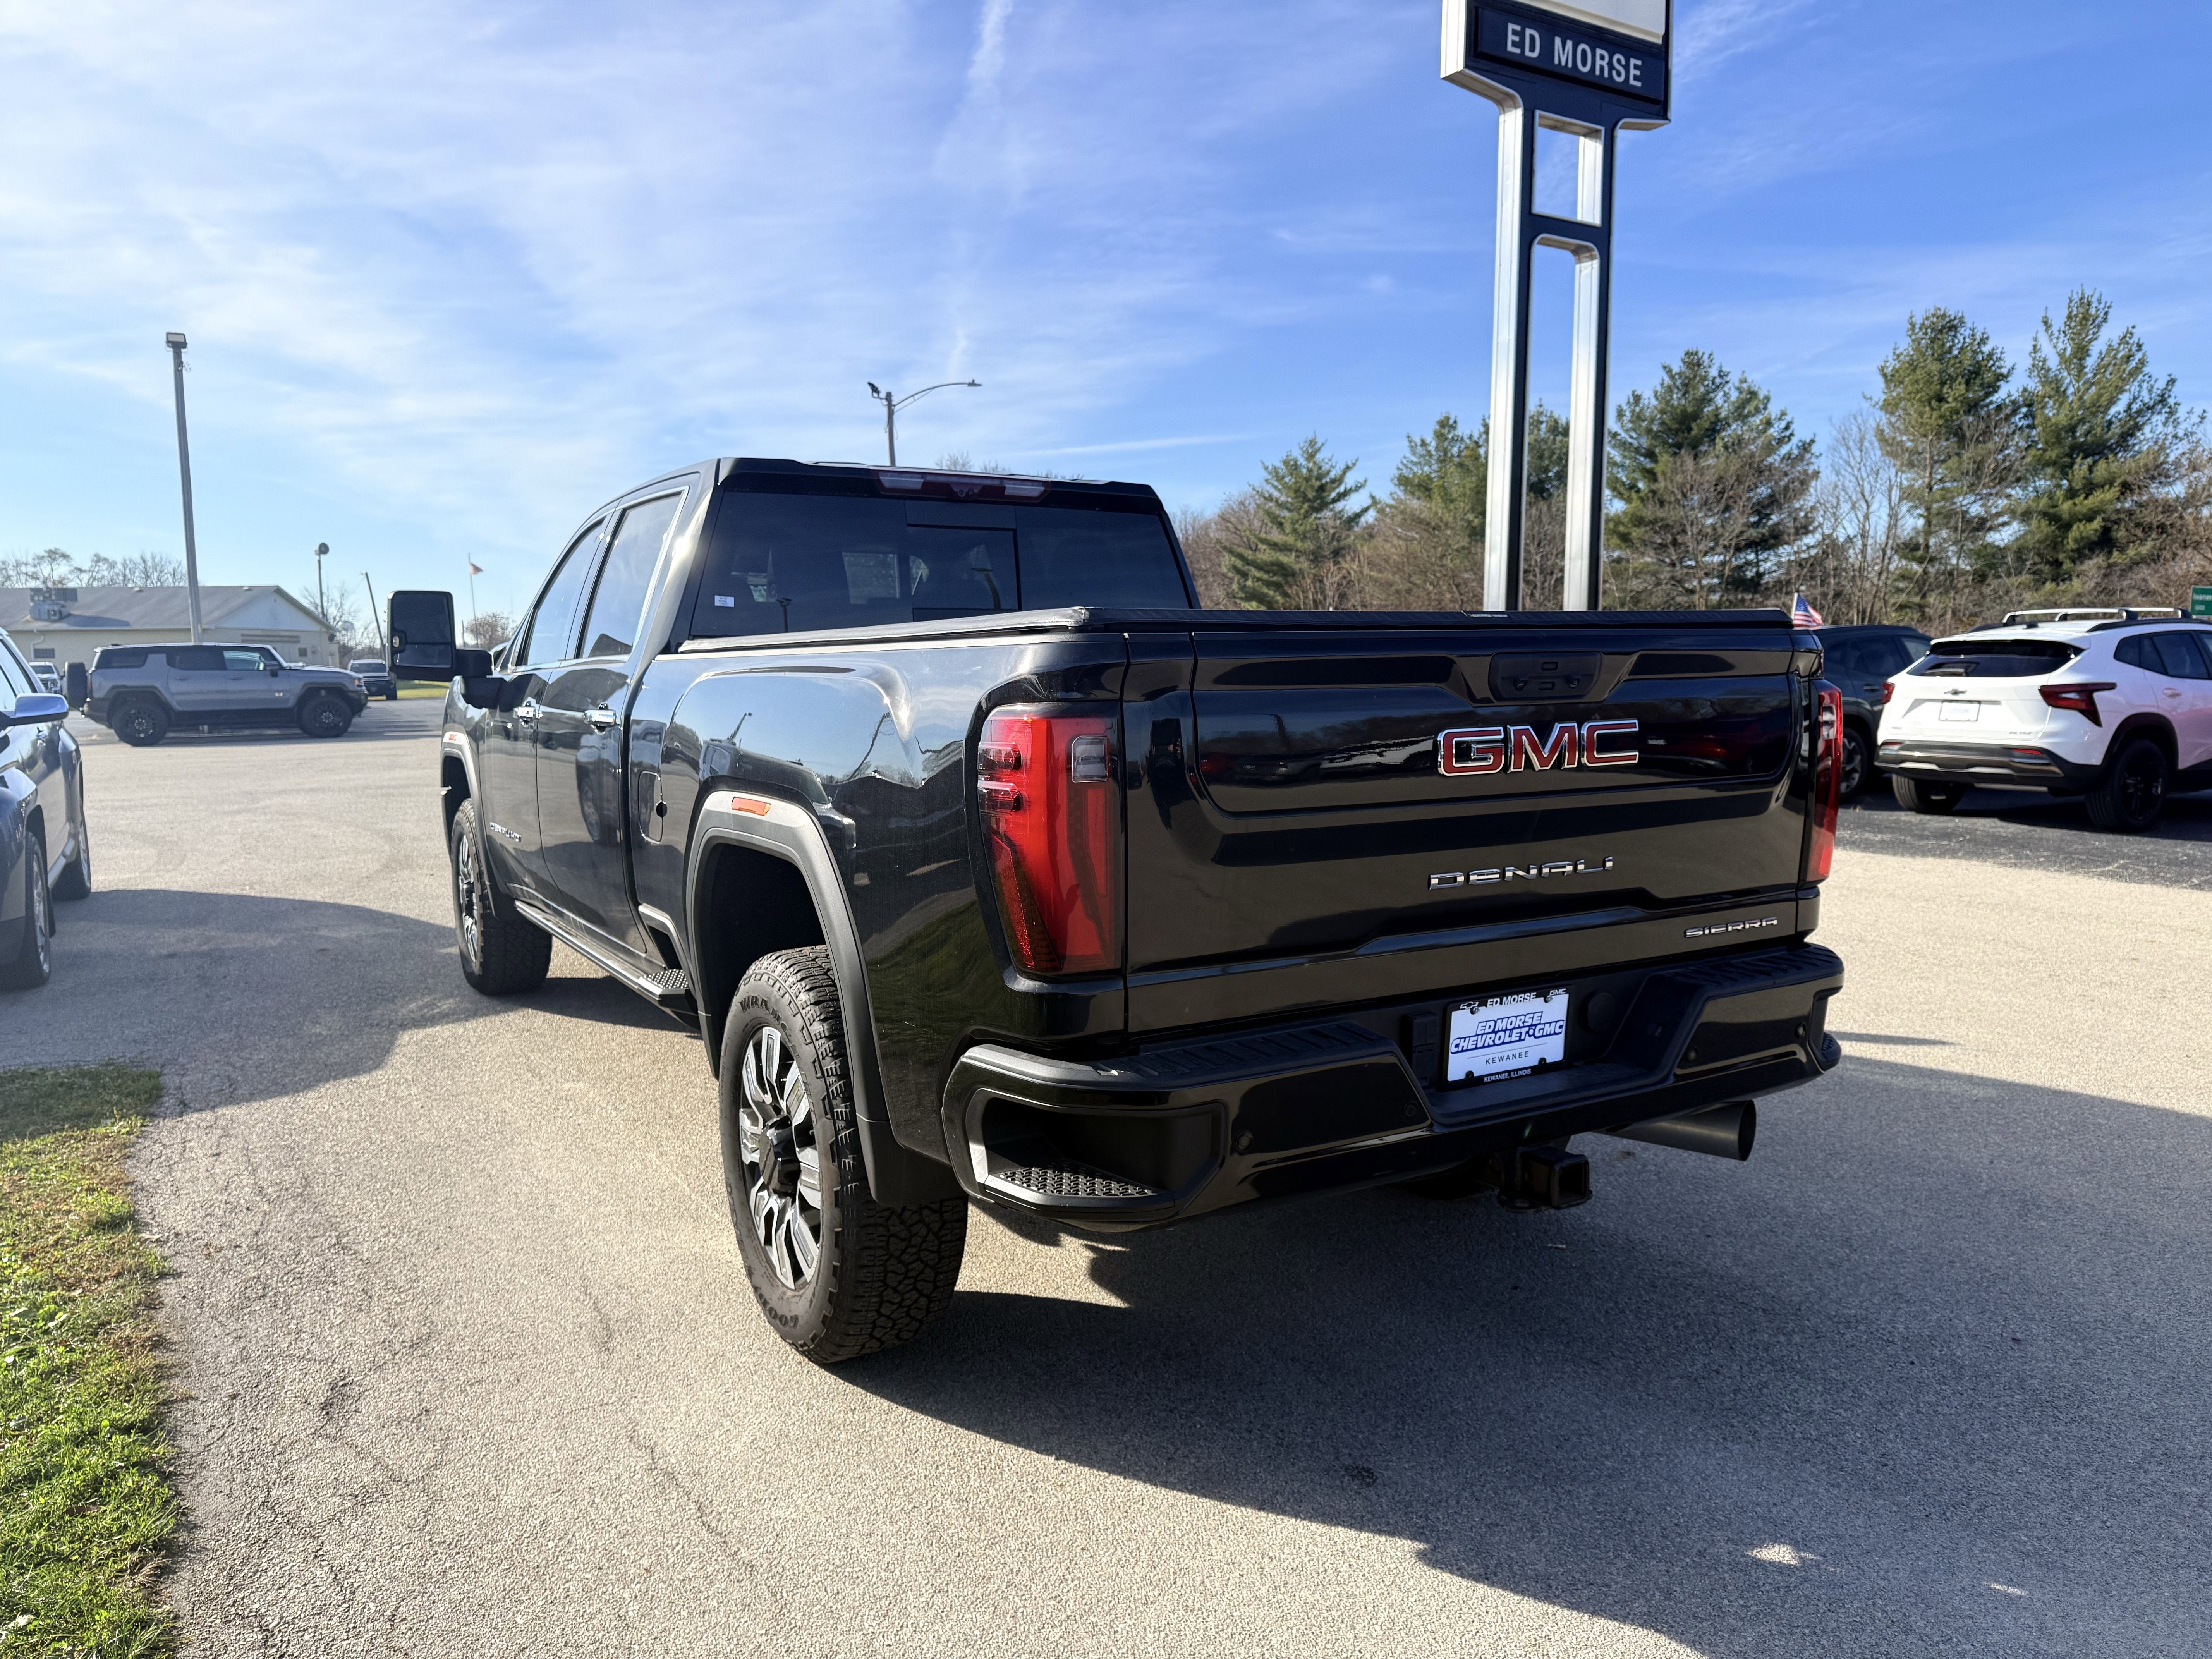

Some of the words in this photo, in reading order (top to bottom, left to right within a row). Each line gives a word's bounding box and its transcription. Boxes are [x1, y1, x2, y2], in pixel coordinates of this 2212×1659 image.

[1507, 22, 1540, 58] ED
[1554, 36, 1642, 88] MORSE
[1437, 718, 1639, 776] GMC
[1428, 856, 1613, 890] DENALI
[1685, 916, 1778, 938] SIERRA
[1487, 998, 1500, 1008] ED
[1502, 992, 1537, 1006] MORSE
[1476, 1020, 1495, 1035] ED
[1495, 1011, 1543, 1031] MORSE
[1486, 1051, 1529, 1065] KEWANEE
[1484, 1073, 1510, 1083] KEWANEE,
[1510, 1069, 1532, 1078] ILLINOIS
